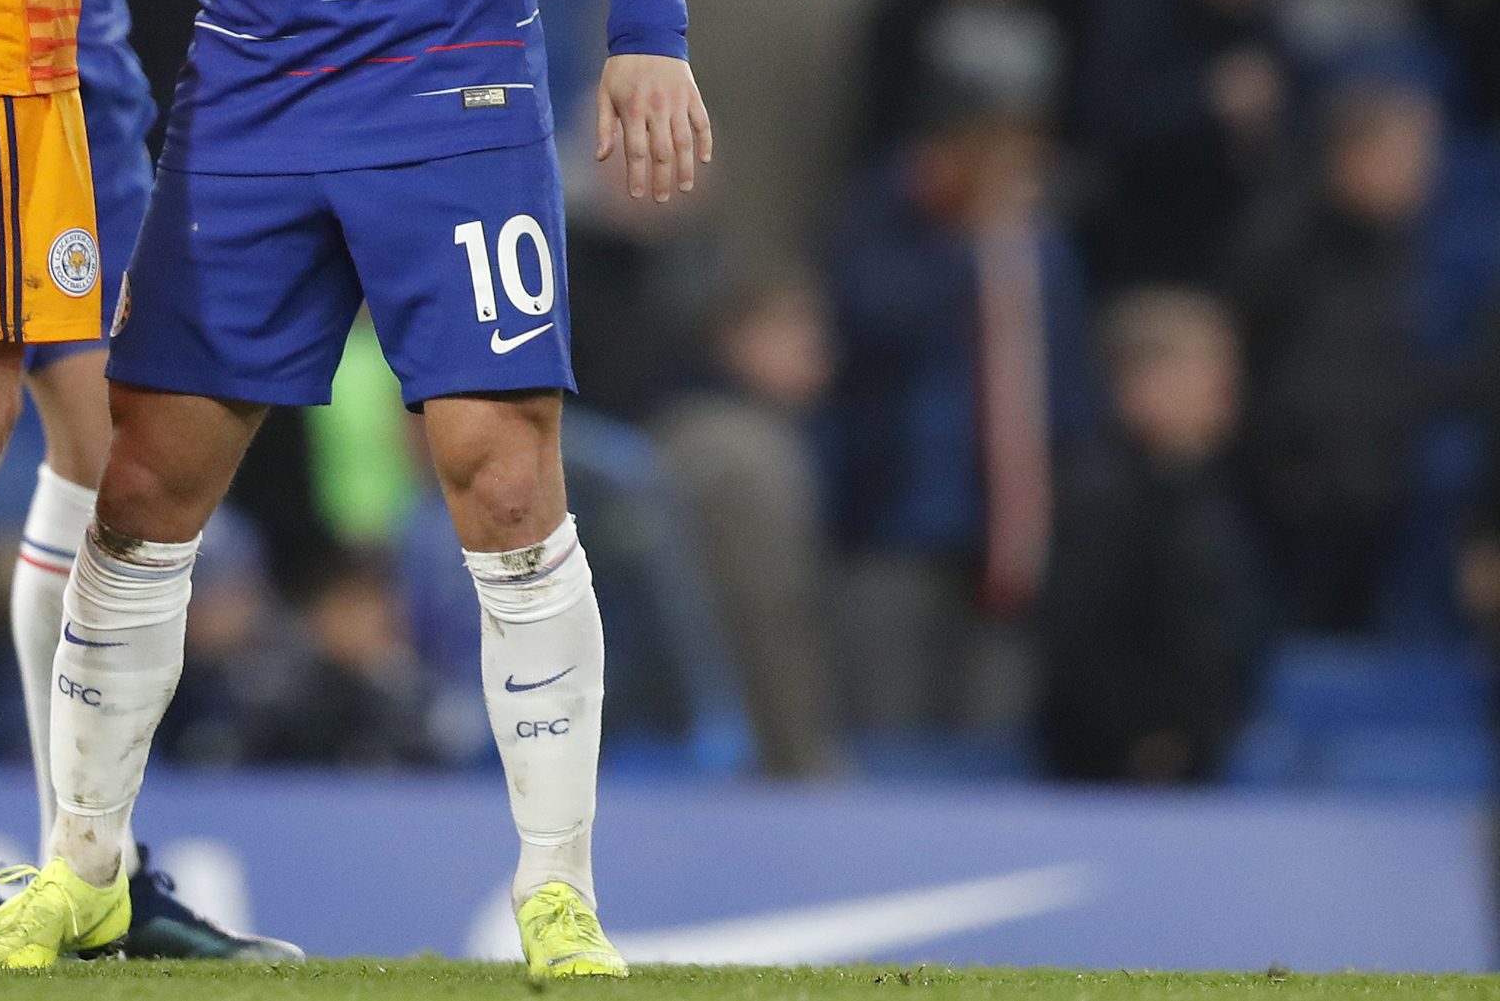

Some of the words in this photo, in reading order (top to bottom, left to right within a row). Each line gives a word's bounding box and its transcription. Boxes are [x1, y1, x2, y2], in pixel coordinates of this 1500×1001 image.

[54, 234, 87, 261] LEICESTER
[54, 265, 86, 289] FOOTBALL
[454, 213, 555, 323] 10
[58, 673, 102, 707] CFC
[516, 717, 570, 739] CFC
